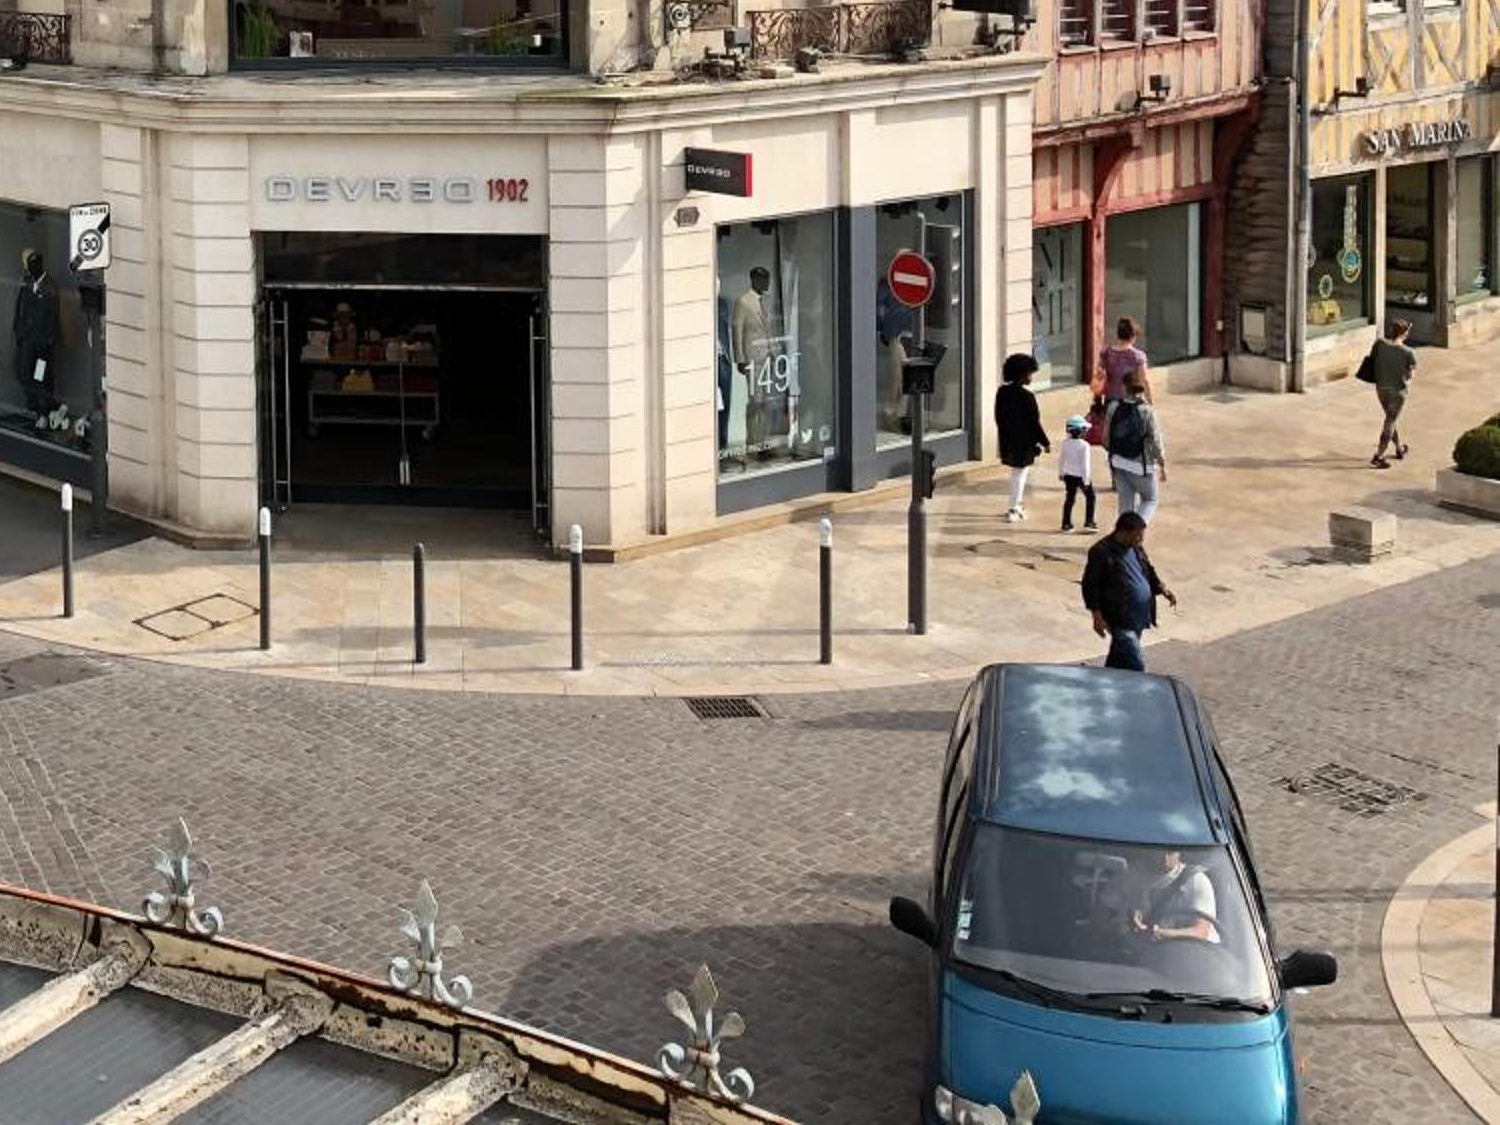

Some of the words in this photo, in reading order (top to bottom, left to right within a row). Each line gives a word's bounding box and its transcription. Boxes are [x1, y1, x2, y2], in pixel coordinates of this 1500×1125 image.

[1366, 128, 1400, 154] SAN
[486, 178, 530, 203] 1902
[83, 236, 99, 252] 30
